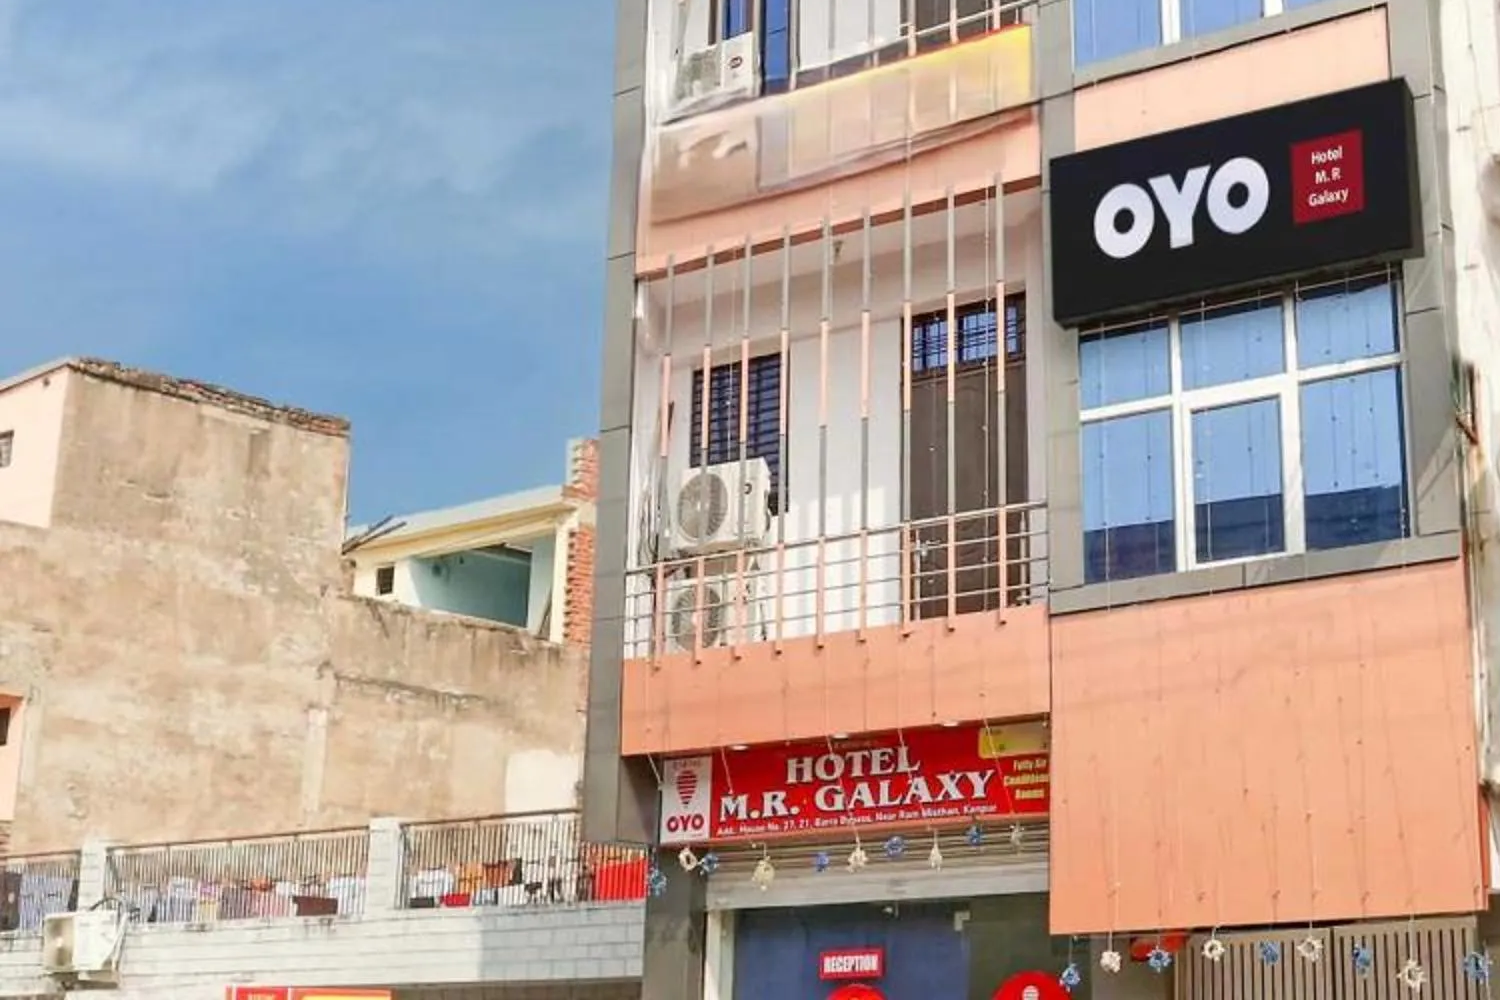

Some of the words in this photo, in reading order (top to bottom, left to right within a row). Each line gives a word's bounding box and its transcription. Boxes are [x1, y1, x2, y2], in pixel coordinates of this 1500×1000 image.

[1310, 145, 1344, 166] Hotel
[1093, 156, 1270, 259] OYO
[1308, 185, 1350, 208] Galaxy
[786, 745, 921, 785] HOTEL
[719, 789, 800, 823] M.R.
[815, 768, 996, 812] GALAXY
[666, 813, 704, 833] OYO
[823, 953, 879, 975] RECEPTION
